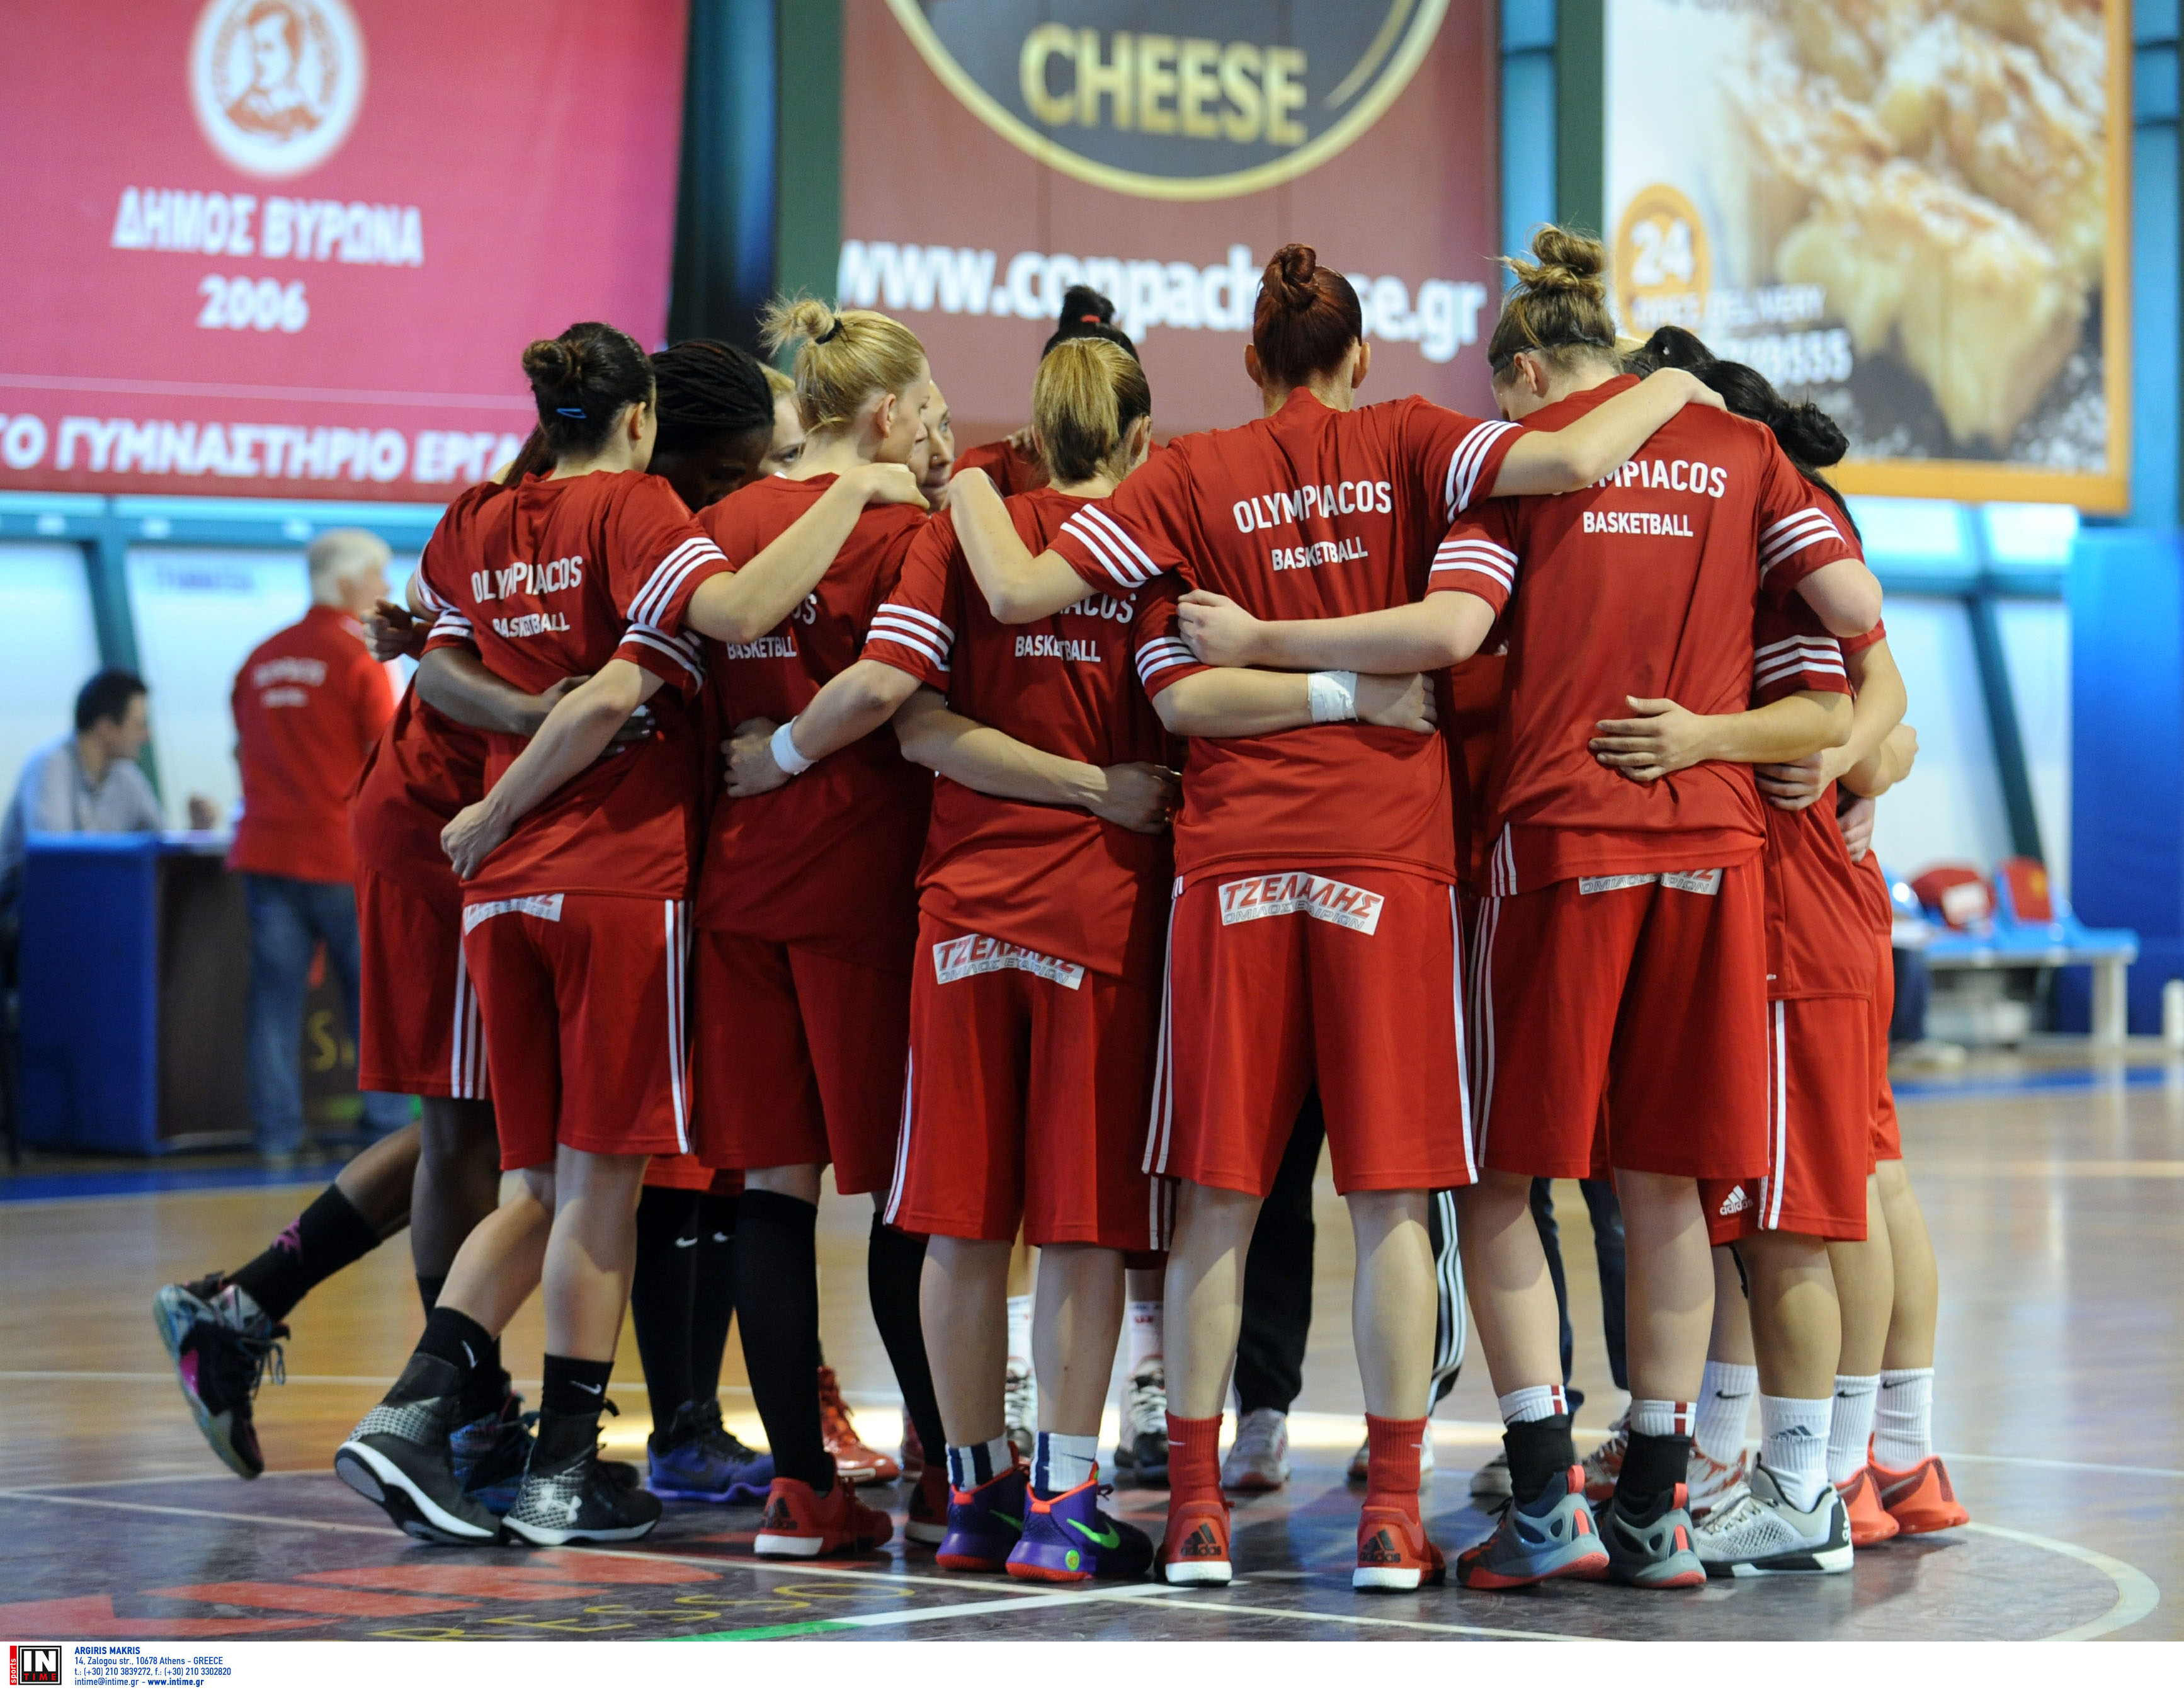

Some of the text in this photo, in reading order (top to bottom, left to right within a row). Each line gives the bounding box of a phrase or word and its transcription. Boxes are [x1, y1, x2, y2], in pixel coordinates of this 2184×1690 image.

[1018, 22, 1308, 147] CHEESE
[111, 186, 424, 268] ΔΗΜΟΣ ΒΥΡΩΝΑ
[1630, 218, 1695, 287] 24
[197, 275, 309, 333] 2006
[0, 413, 48, 470] Ο
[55, 415, 407, 484] ΓΥΜΝΑΣΤΗΡΙΟ
[1232, 480, 1392, 534] OLYMPIACOS
[1583, 511, 1693, 537] BASKETBALL
[1271, 536, 1368, 571] BASKETBALL
[1719, 1199, 1754, 1216] adidas
